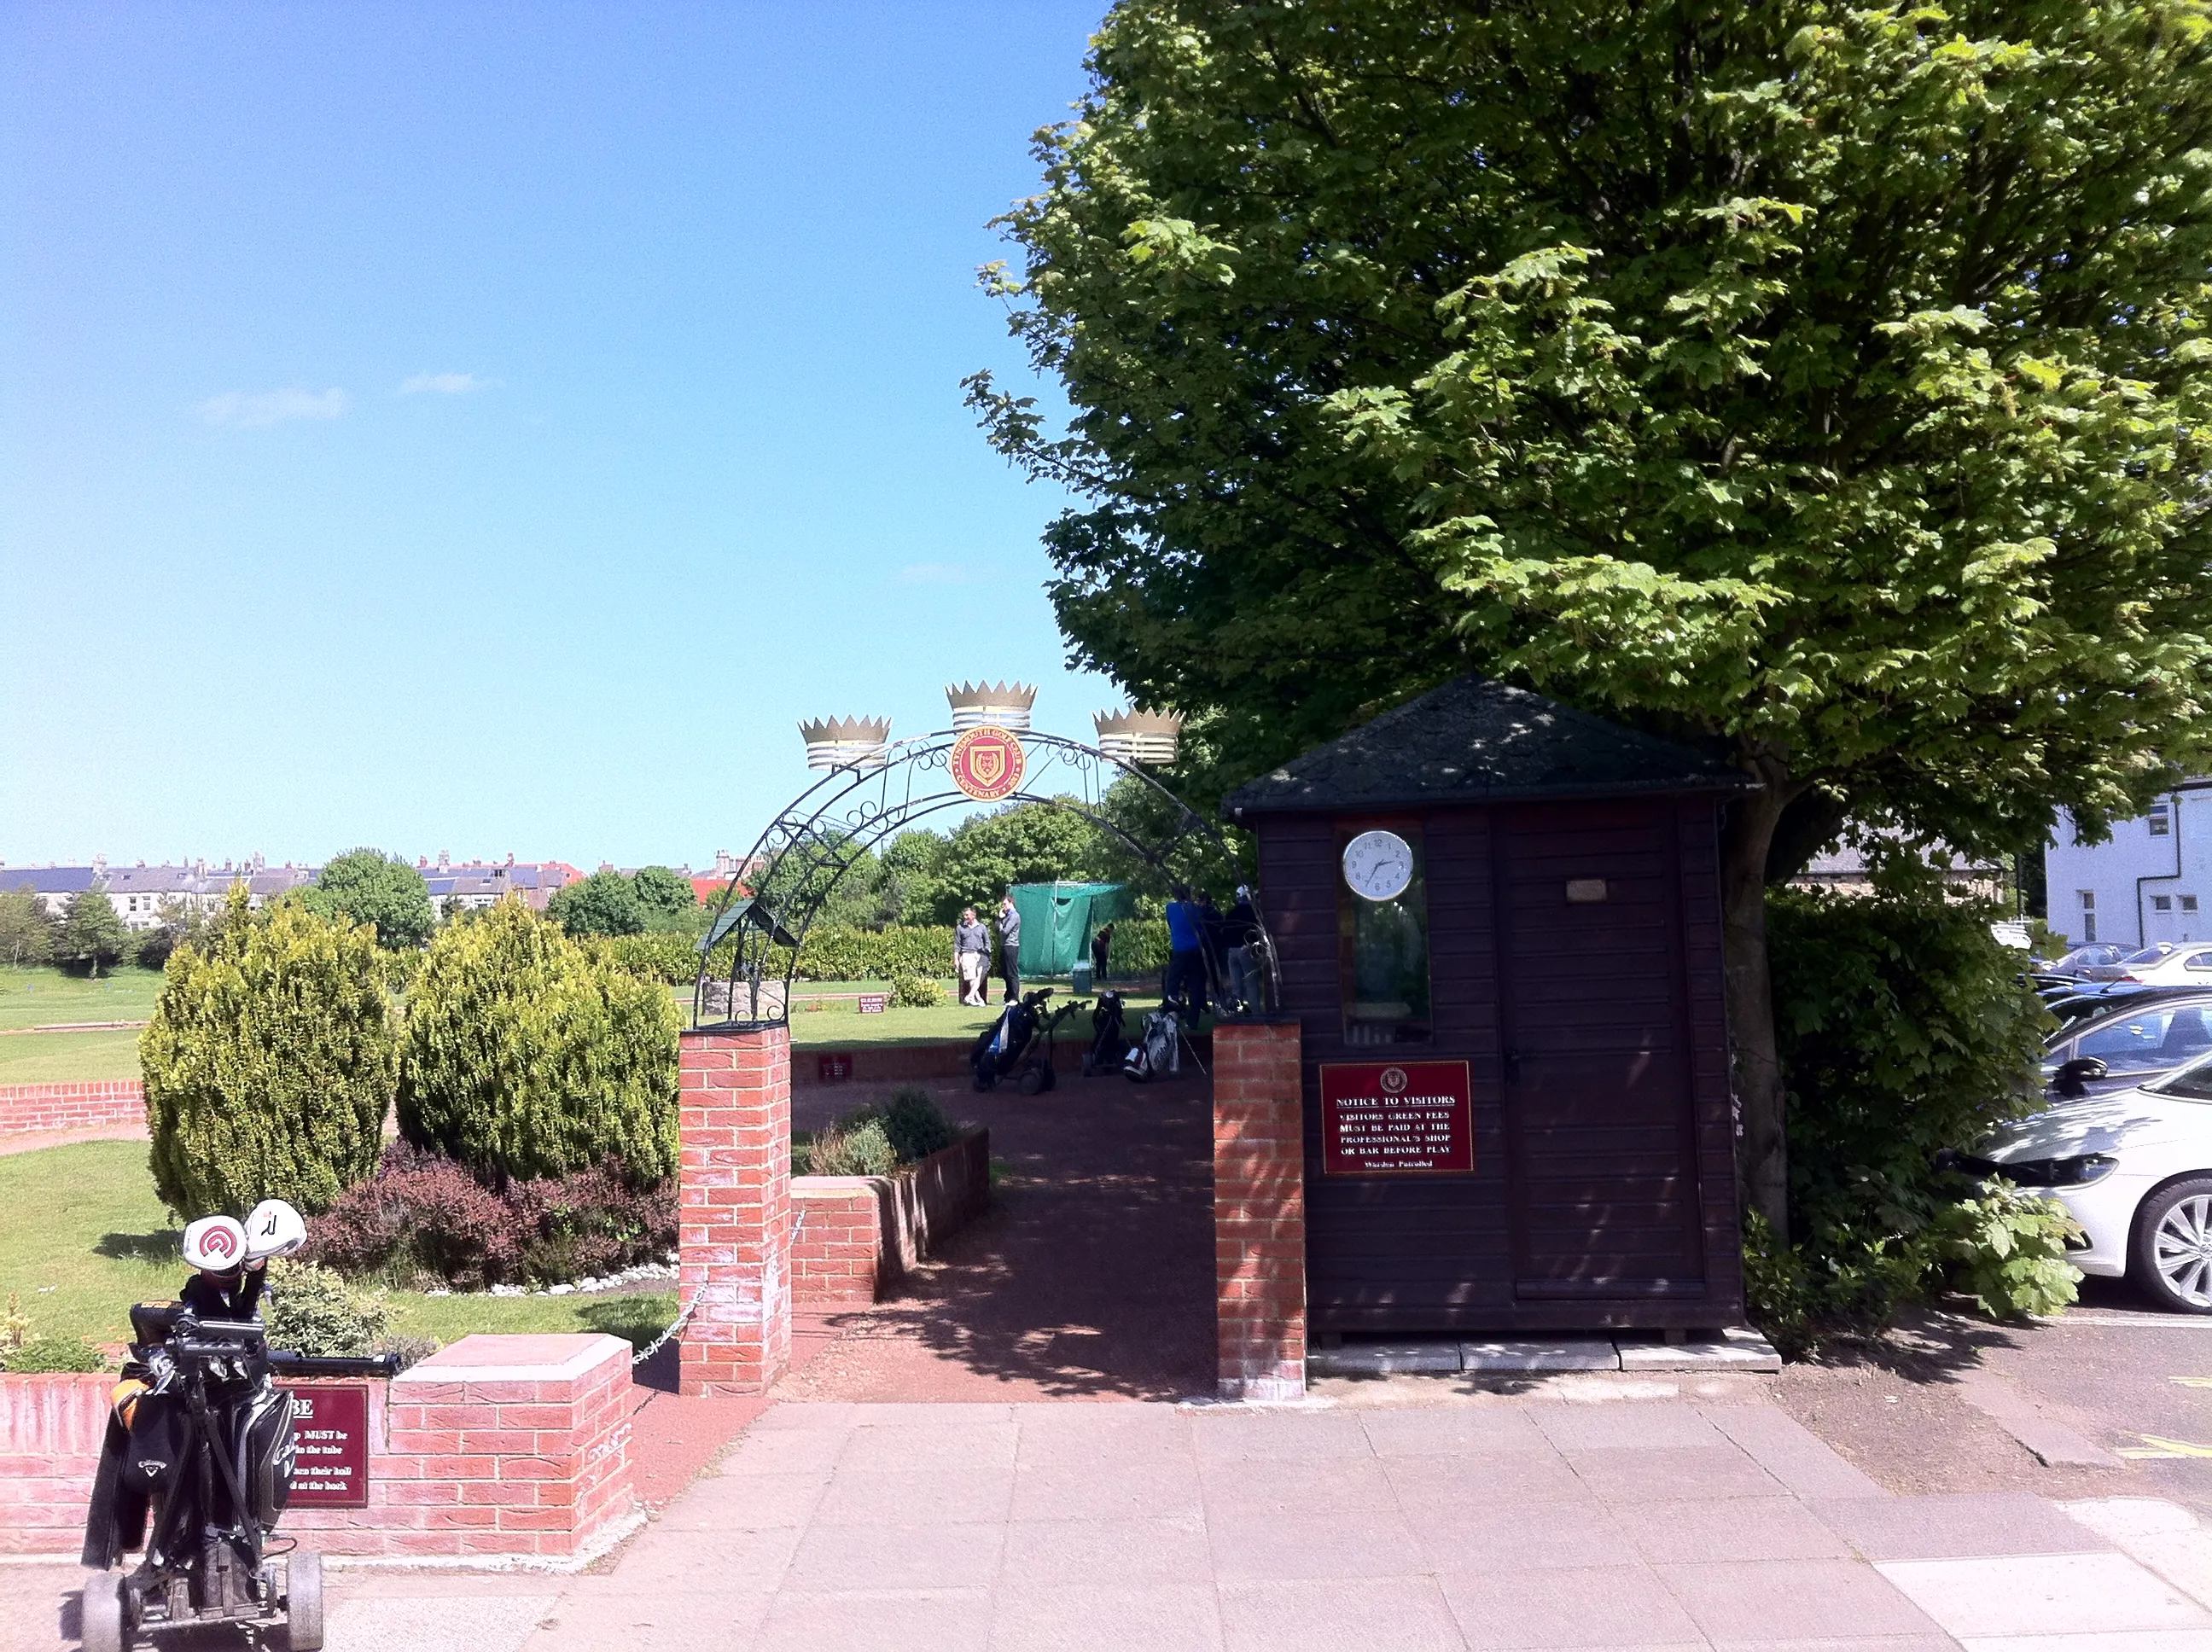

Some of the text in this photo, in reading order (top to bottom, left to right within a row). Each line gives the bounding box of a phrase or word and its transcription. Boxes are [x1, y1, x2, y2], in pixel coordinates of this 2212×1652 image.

[952, 729, 1022, 765] TYNEMOUTH GOLF CLUB
[956, 774, 1000, 798] CENTENARY
[1374, 839, 1382, 847] 12
[1355, 850, 1364, 858] 10
[1351, 860, 1357, 869] 9
[1374, 882, 1380, 891] 6
[1386, 880, 1391, 888] 5
[1336, 1096, 1456, 1107] NOTICE TO VISITORS
[1339, 1111, 1450, 1121] VISITORS GREEN FEES
[1340, 1124, 1366, 1132] MUST
[1388, 1123, 1411, 1131] PAID
[1341, 1135, 1421, 1143] PROFESSIONAL'S
[1341, 1147, 1355, 1155] OR
[1383, 1146, 1423, 1155] BEFORE
[1426, 1145, 1451, 1154] PLAY
[305, 1430, 335, 1440] MUST
[335, 1431, 348, 1440] be
[306, 1445, 321, 1454] the
[322, 1445, 343, 1454] tube
[310, 1467, 333, 1475] their
[333, 1466, 352, 1475] ball
[298, 1481, 306, 1490] at
[308, 1481, 323, 1490] the
[324, 1481, 347, 1490] back
